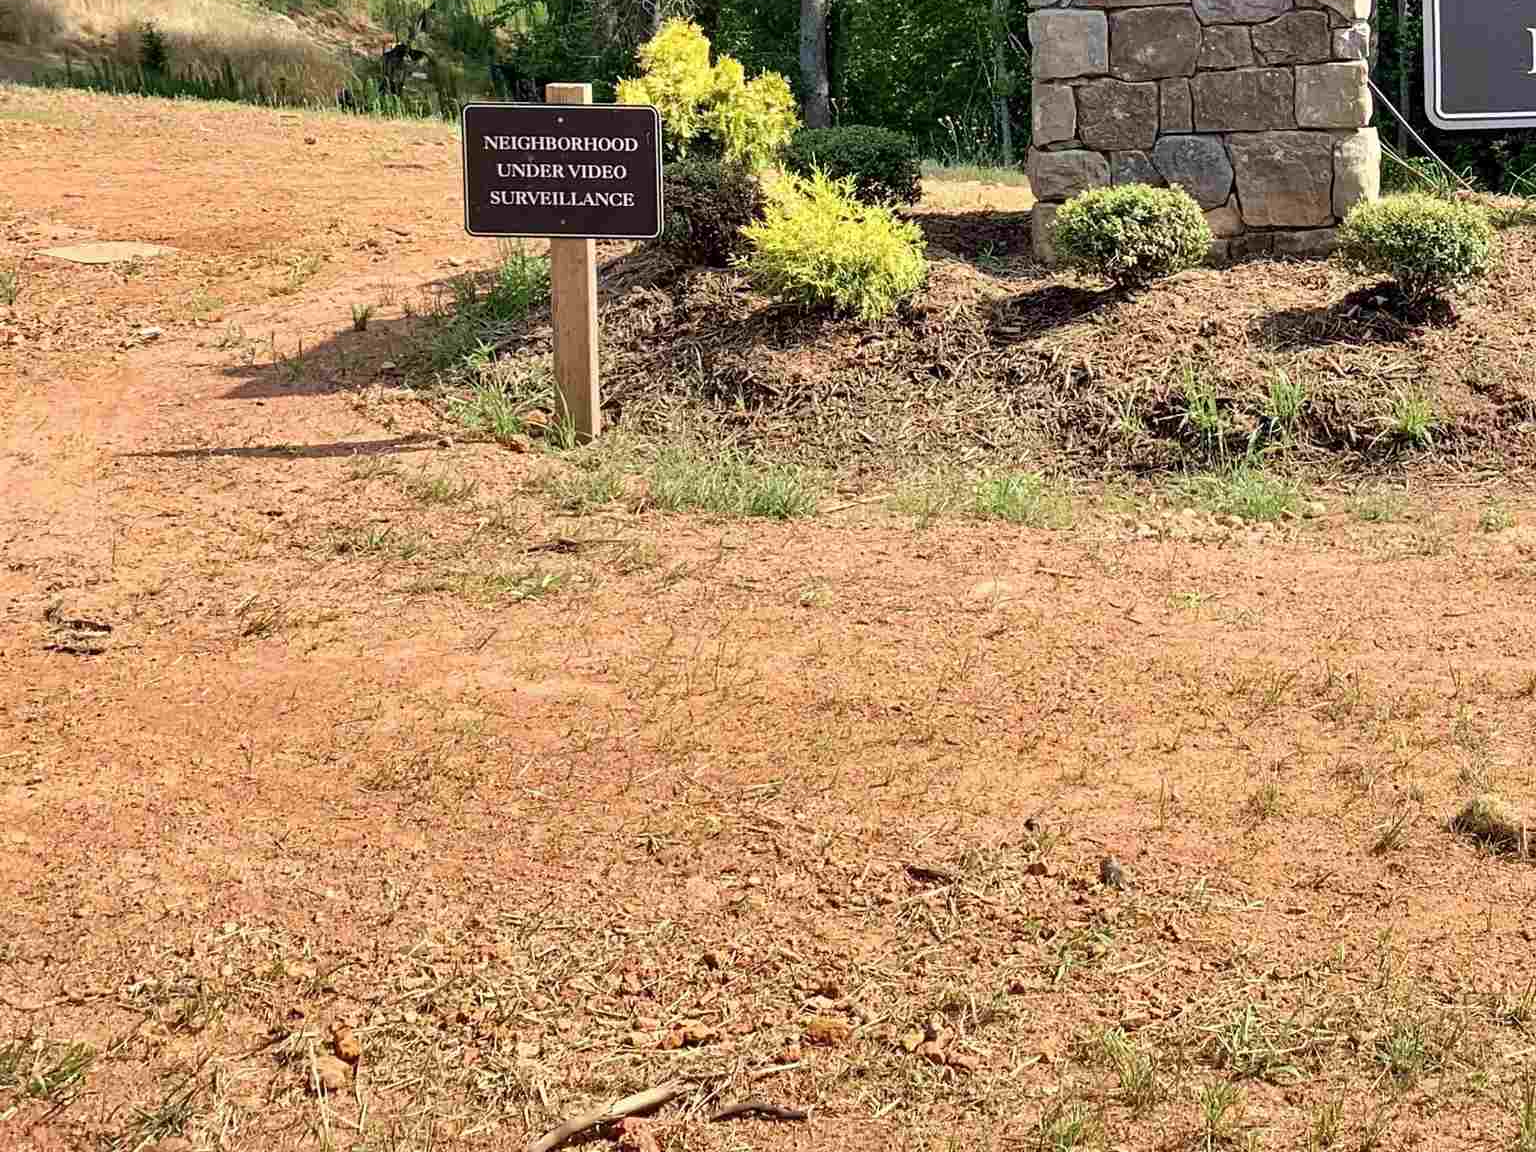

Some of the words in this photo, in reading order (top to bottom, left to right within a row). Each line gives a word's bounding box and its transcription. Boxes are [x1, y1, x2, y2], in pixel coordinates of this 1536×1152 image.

[483, 135, 639, 152] NEIGHBORHOOD
[497, 163, 565, 178] UNDER
[567, 164, 627, 179] VIDEO
[490, 190, 635, 207] SURVEILLANCE
